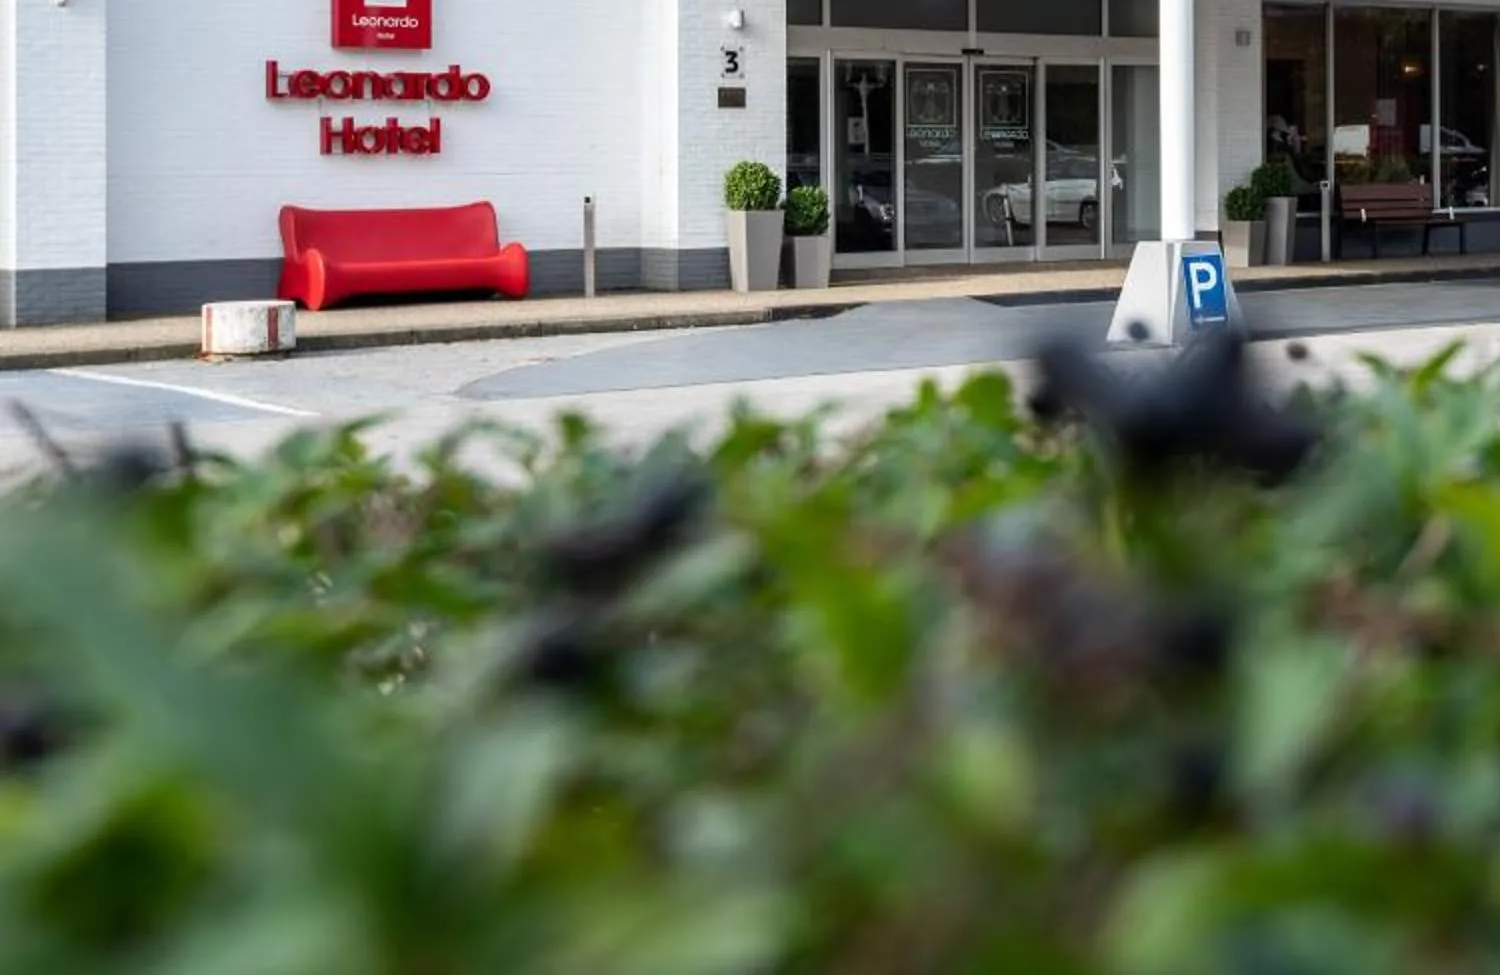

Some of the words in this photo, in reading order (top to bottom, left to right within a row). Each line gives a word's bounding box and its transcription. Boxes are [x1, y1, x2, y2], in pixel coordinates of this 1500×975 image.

[352, 13, 419, 29] Leonardo
[265, 60, 491, 101] Leonardo
[725, 50, 739, 74] 3
[320, 116, 441, 155] Hotel
[1189, 261, 1217, 309] P
